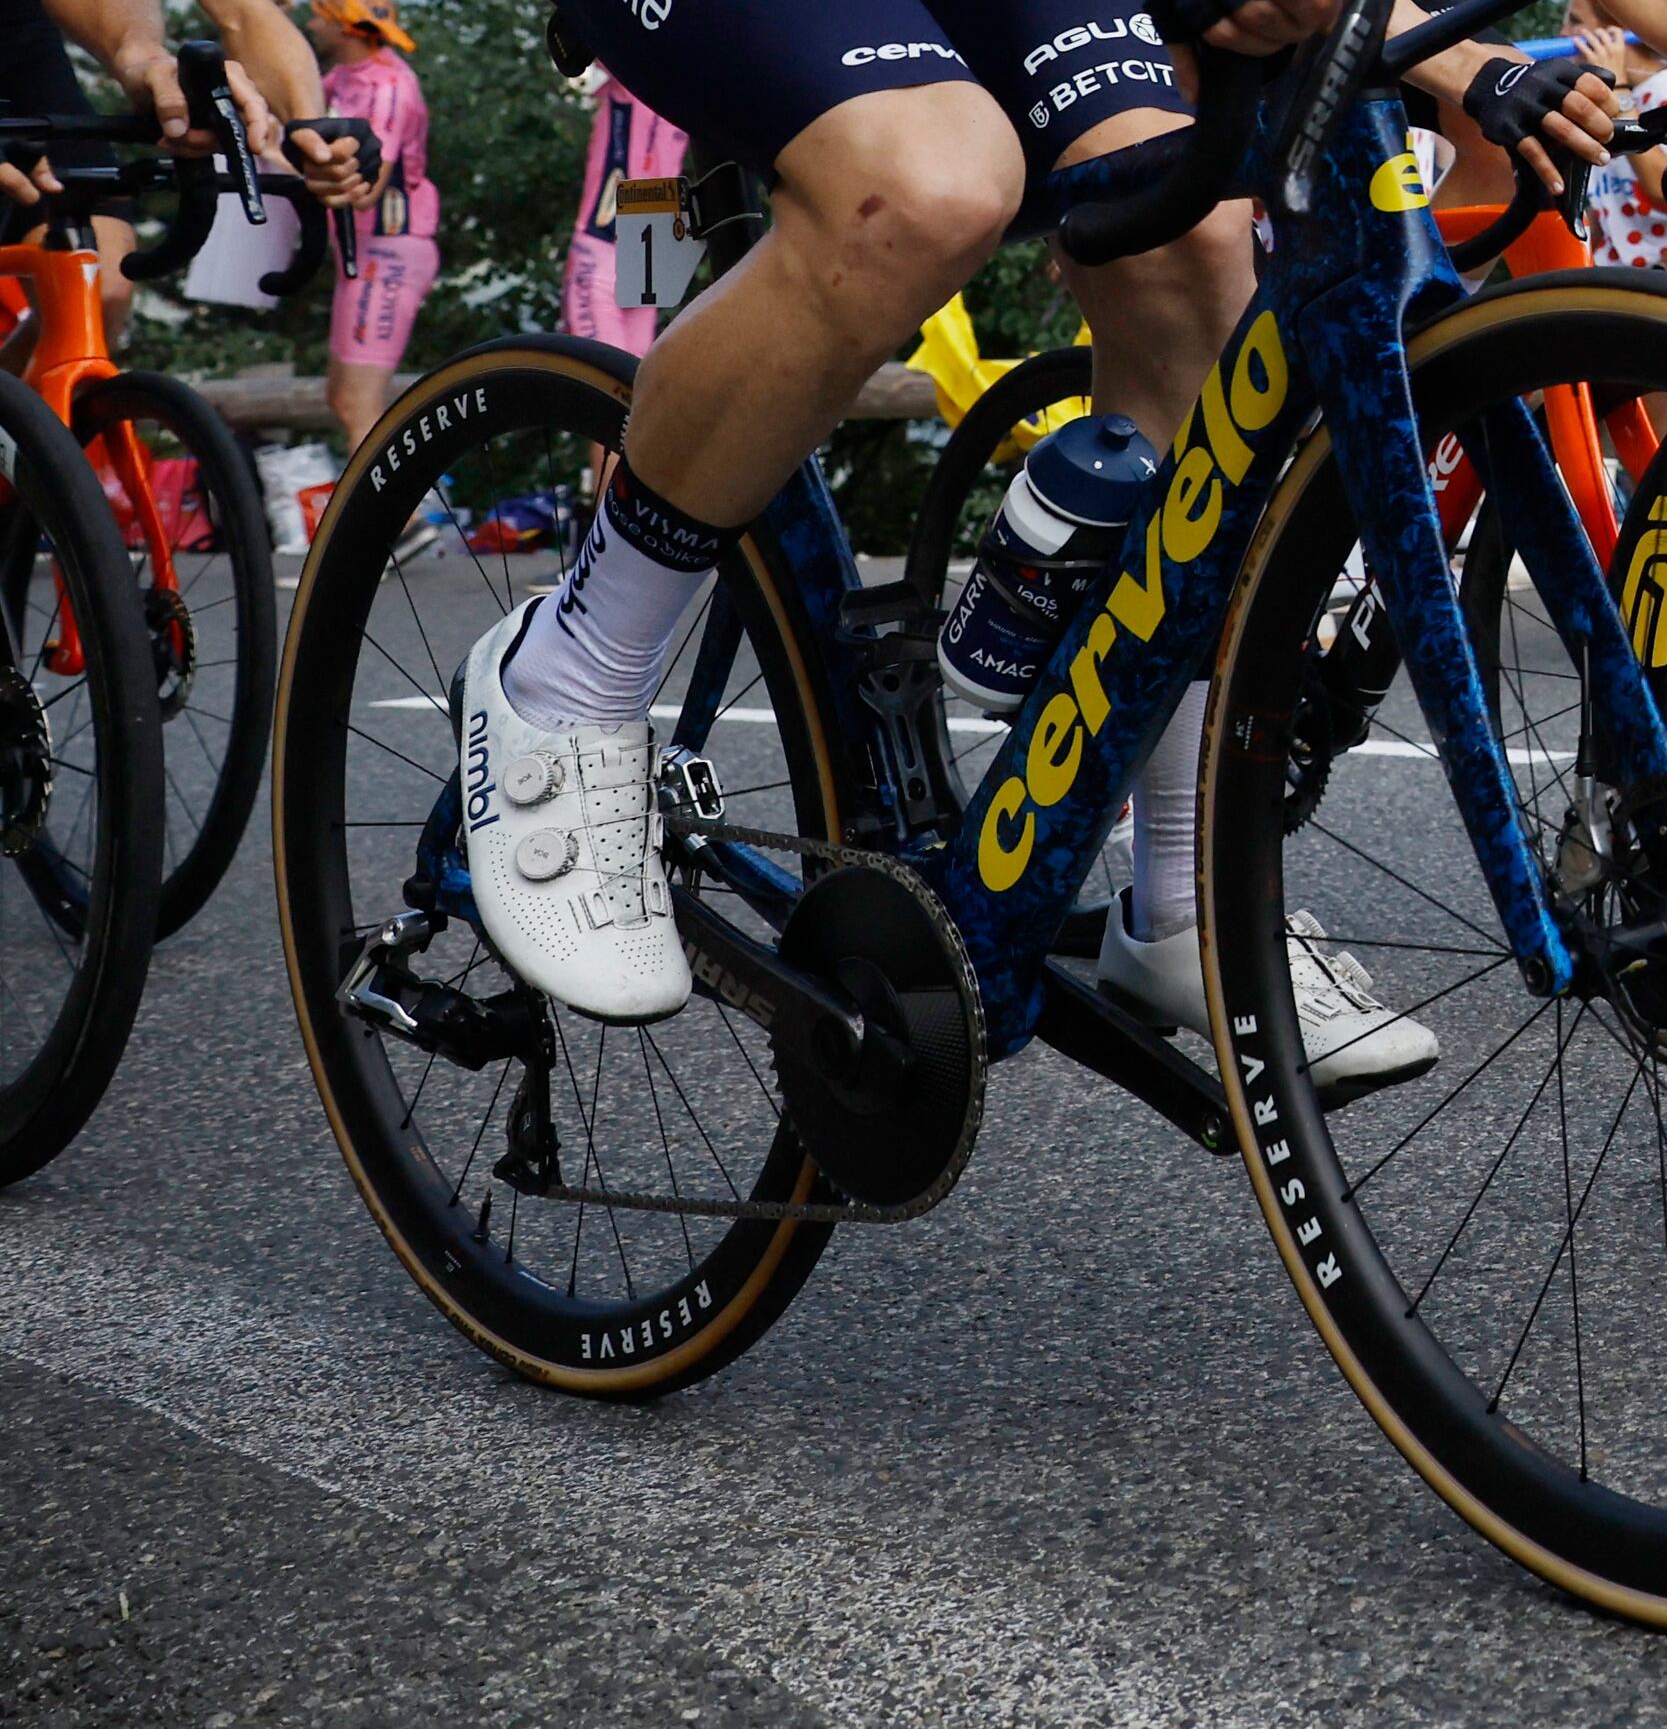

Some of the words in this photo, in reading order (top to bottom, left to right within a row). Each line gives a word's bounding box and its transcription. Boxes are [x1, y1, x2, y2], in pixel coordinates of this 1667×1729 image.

[1023, 16, 1128, 76] AGU
[616, 180, 668, 210] Continental
[640, 223, 657, 306] 1
[370, 386, 491, 493] RESERVE
[635, 498, 720, 551] VISMA
[978, 310, 1289, 893] cervélo
[467, 708, 500, 834] nimbl
[1233, 1011, 1342, 1290] RESERVE
[581, 1279, 713, 1359] RESERVE
